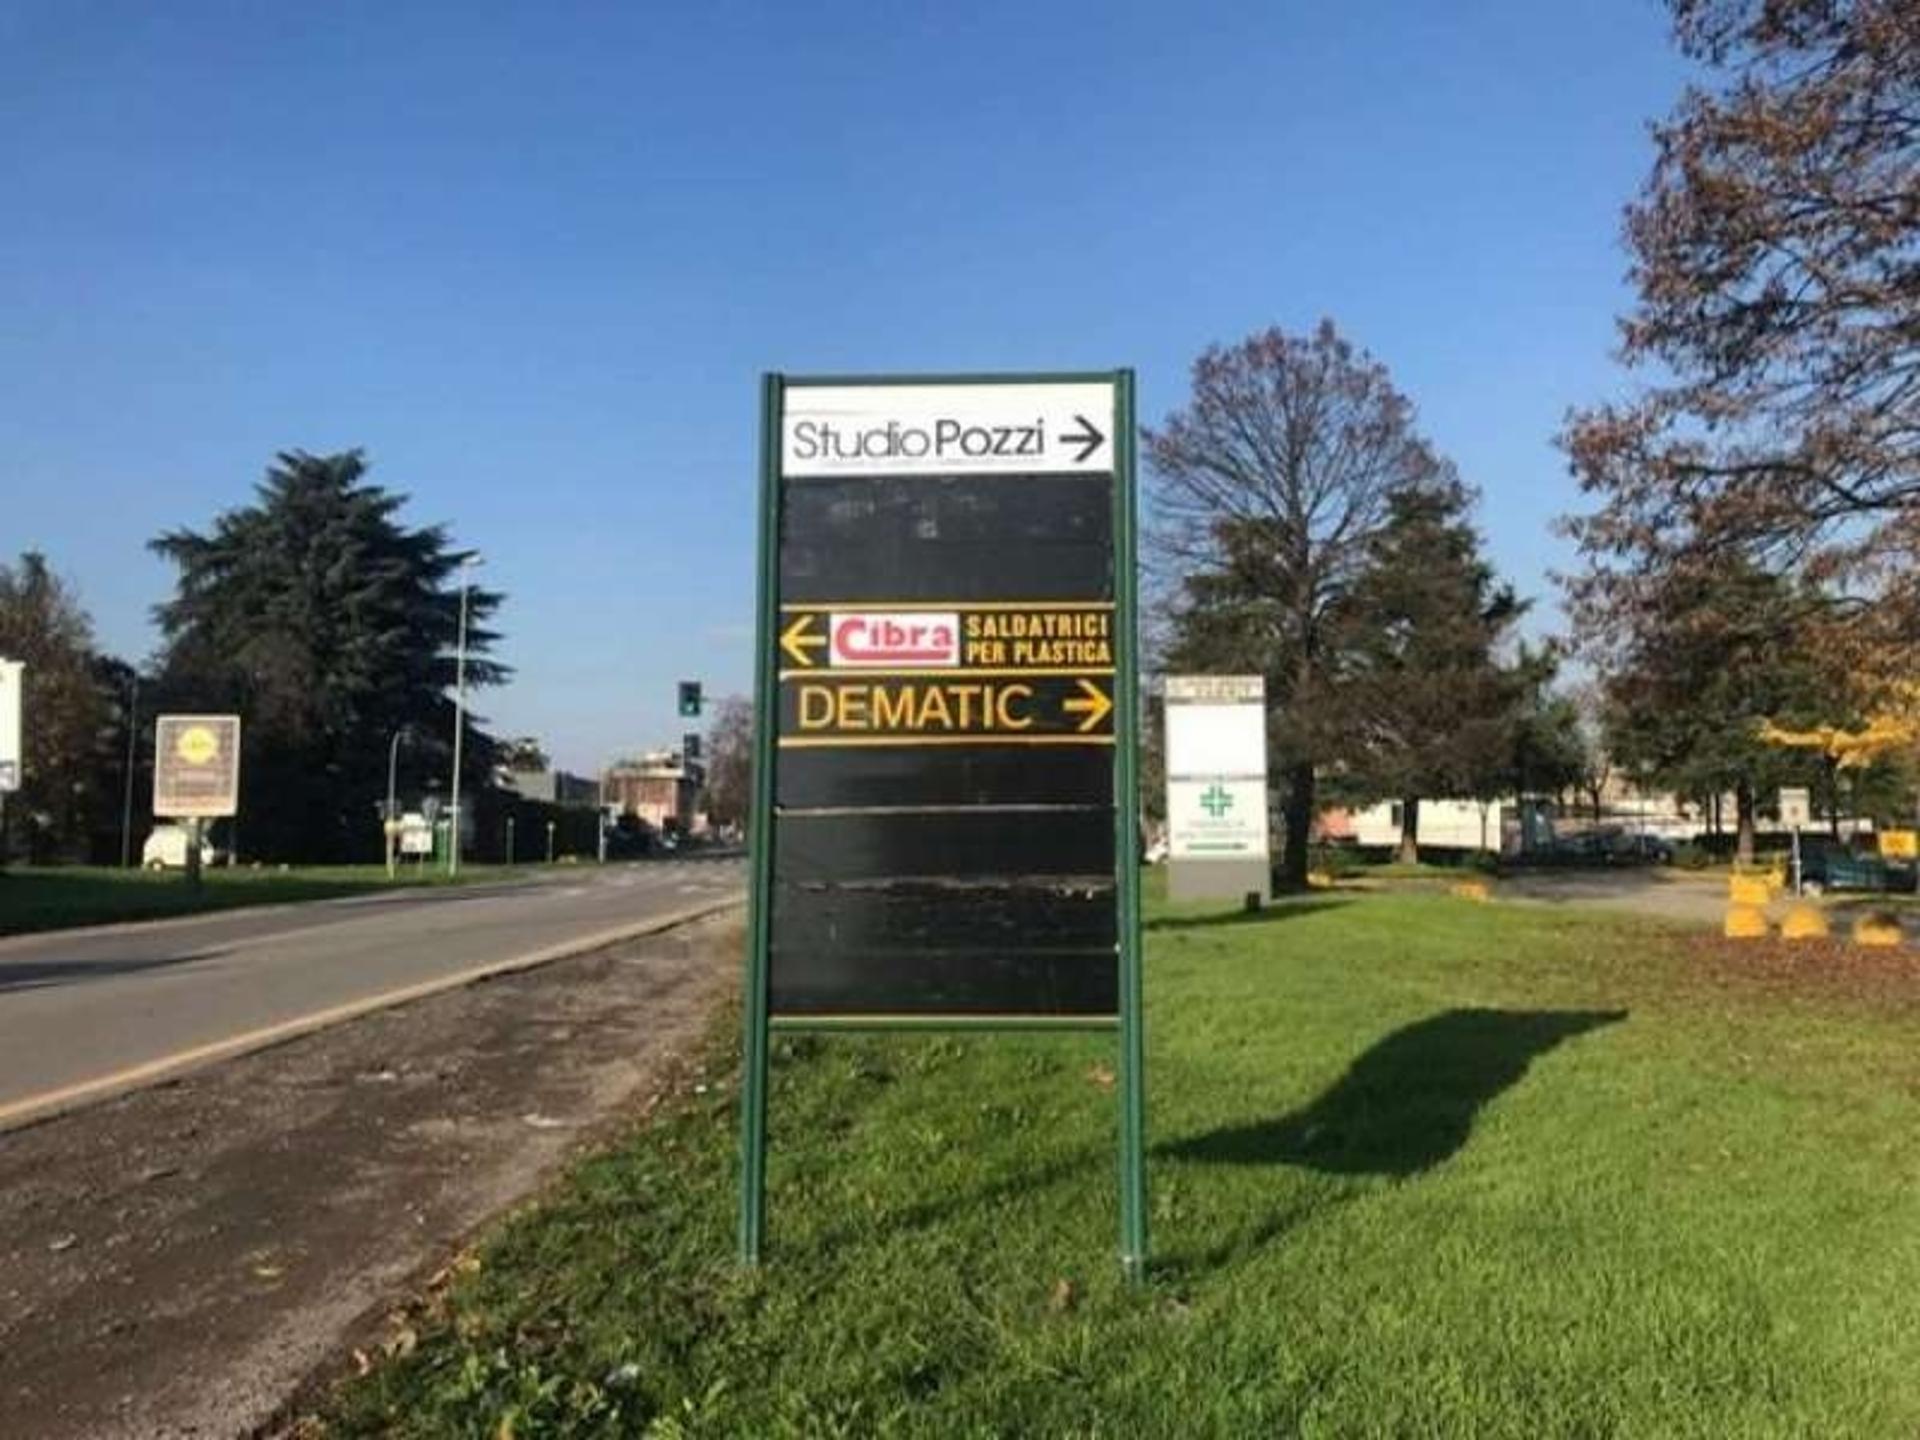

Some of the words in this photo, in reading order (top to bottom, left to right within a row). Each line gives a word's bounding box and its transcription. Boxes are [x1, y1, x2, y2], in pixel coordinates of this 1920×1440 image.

[793, 421, 930, 458] Studio
[935, 418, 1045, 456] Pozzi
[835, 616, 954, 661] Cibra
[967, 613, 1108, 637] SALDATRICI
[967, 641, 1003, 663] PER
[1013, 640, 1110, 663] PLASTICA
[800, 685, 1032, 729] DEMATIC
